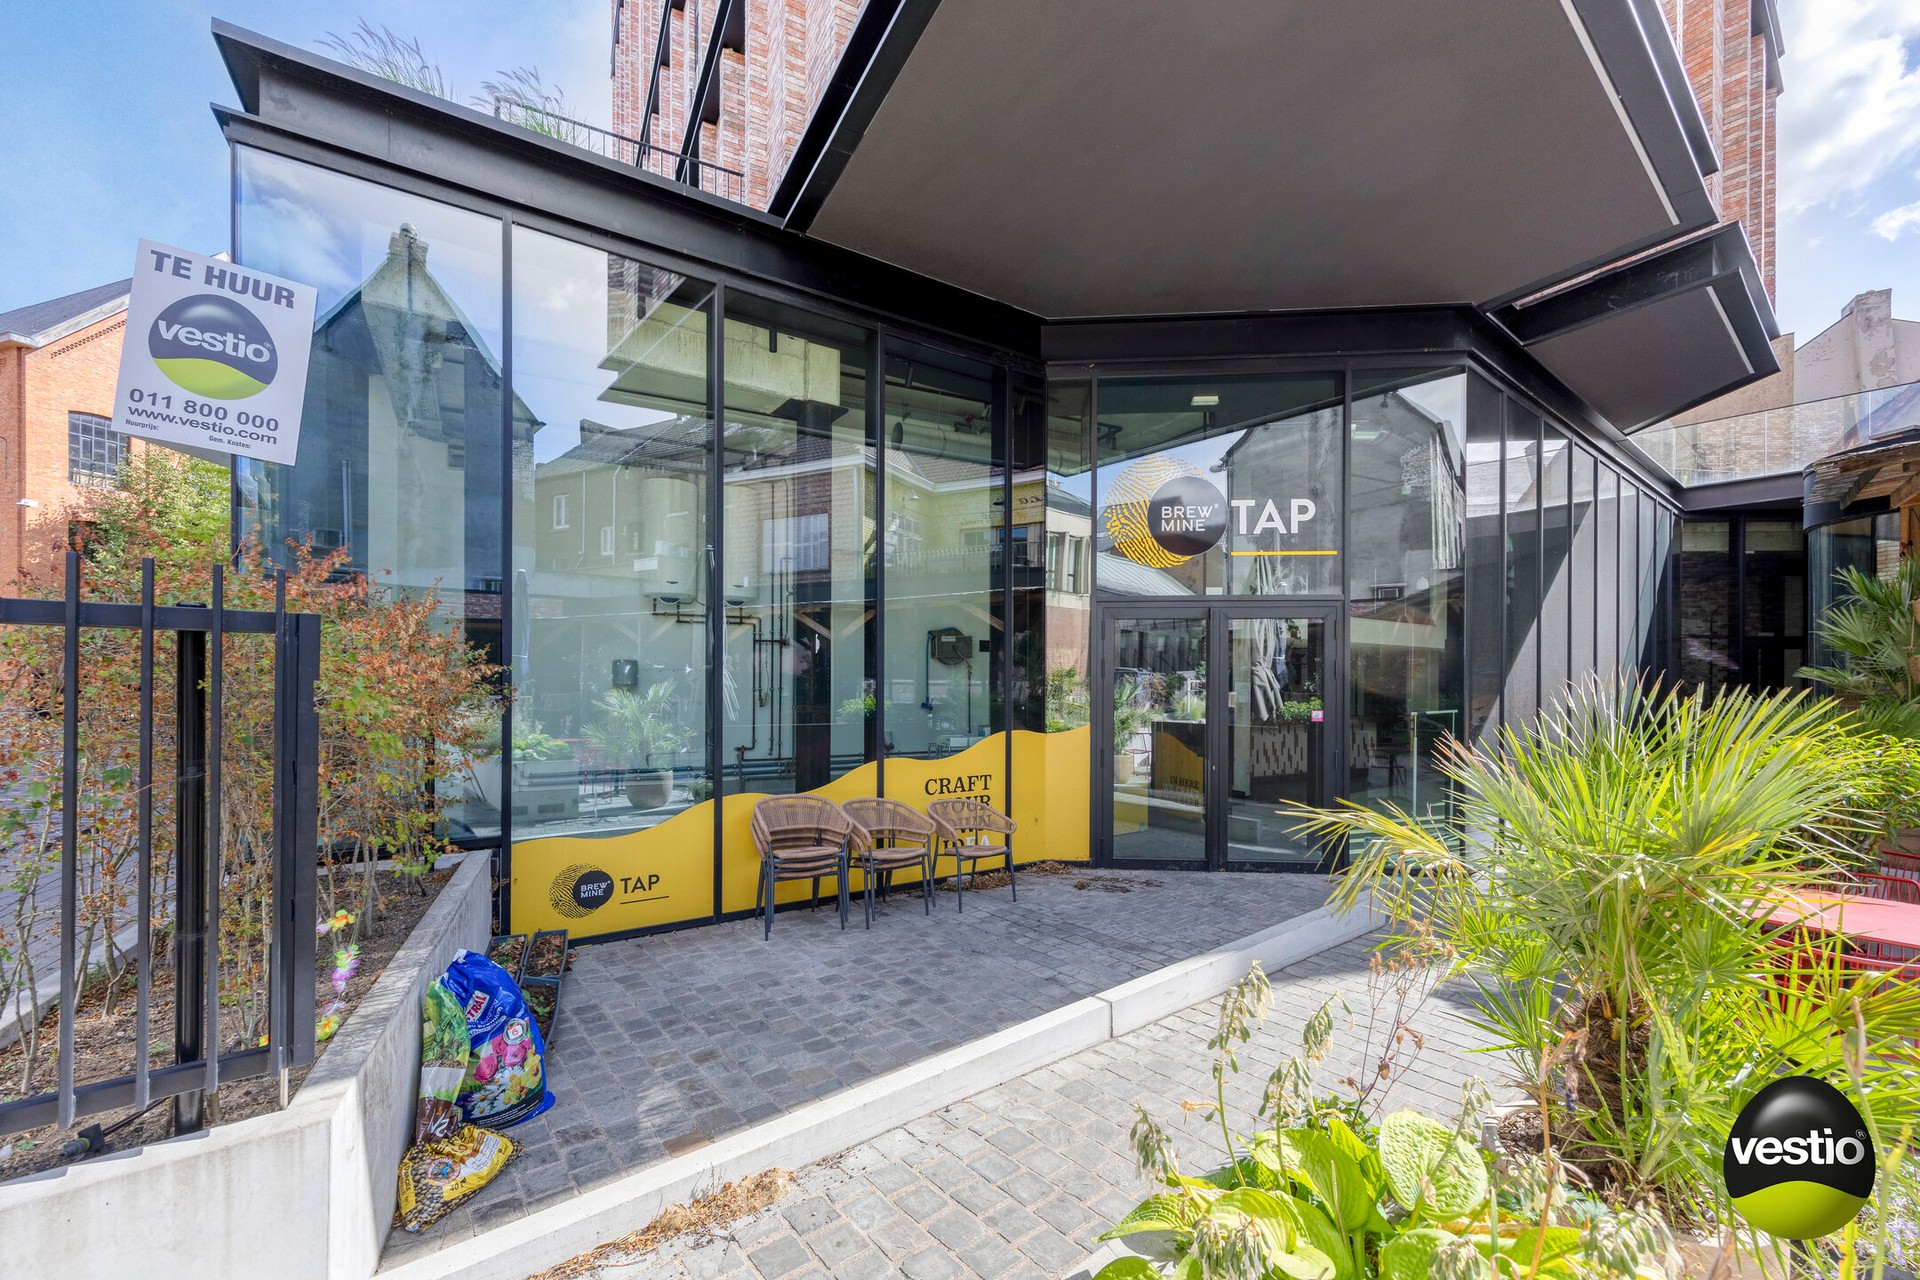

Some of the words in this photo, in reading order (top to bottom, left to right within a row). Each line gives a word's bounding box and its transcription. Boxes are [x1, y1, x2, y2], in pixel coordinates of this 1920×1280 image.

[150, 249, 192, 280] TE
[203, 265, 295, 310] HUUR
[157, 319, 271, 363] vestio
[129, 388, 172, 409] 011
[183, 399, 228, 421] 800
[236, 411, 279, 432] 000
[125, 418, 160, 432] Huurprijs:
[127, 405, 277, 445] www.vestio.com
[208, 434, 226, 444] Gem.
[227, 439, 252, 450] Kosten:
[1161, 505, 1213, 518] BREW
[1230, 498, 1317, 535] TAP
[1161, 519, 1206, 531] MINE
[924, 774, 992, 796] CRAFT
[1170, 775, 1178, 784] IN
[1179, 777, 1199, 789] HERE
[581, 882, 608, 892] BREW
[620, 874, 660, 894] TAP
[580, 889, 604, 898] MINE
